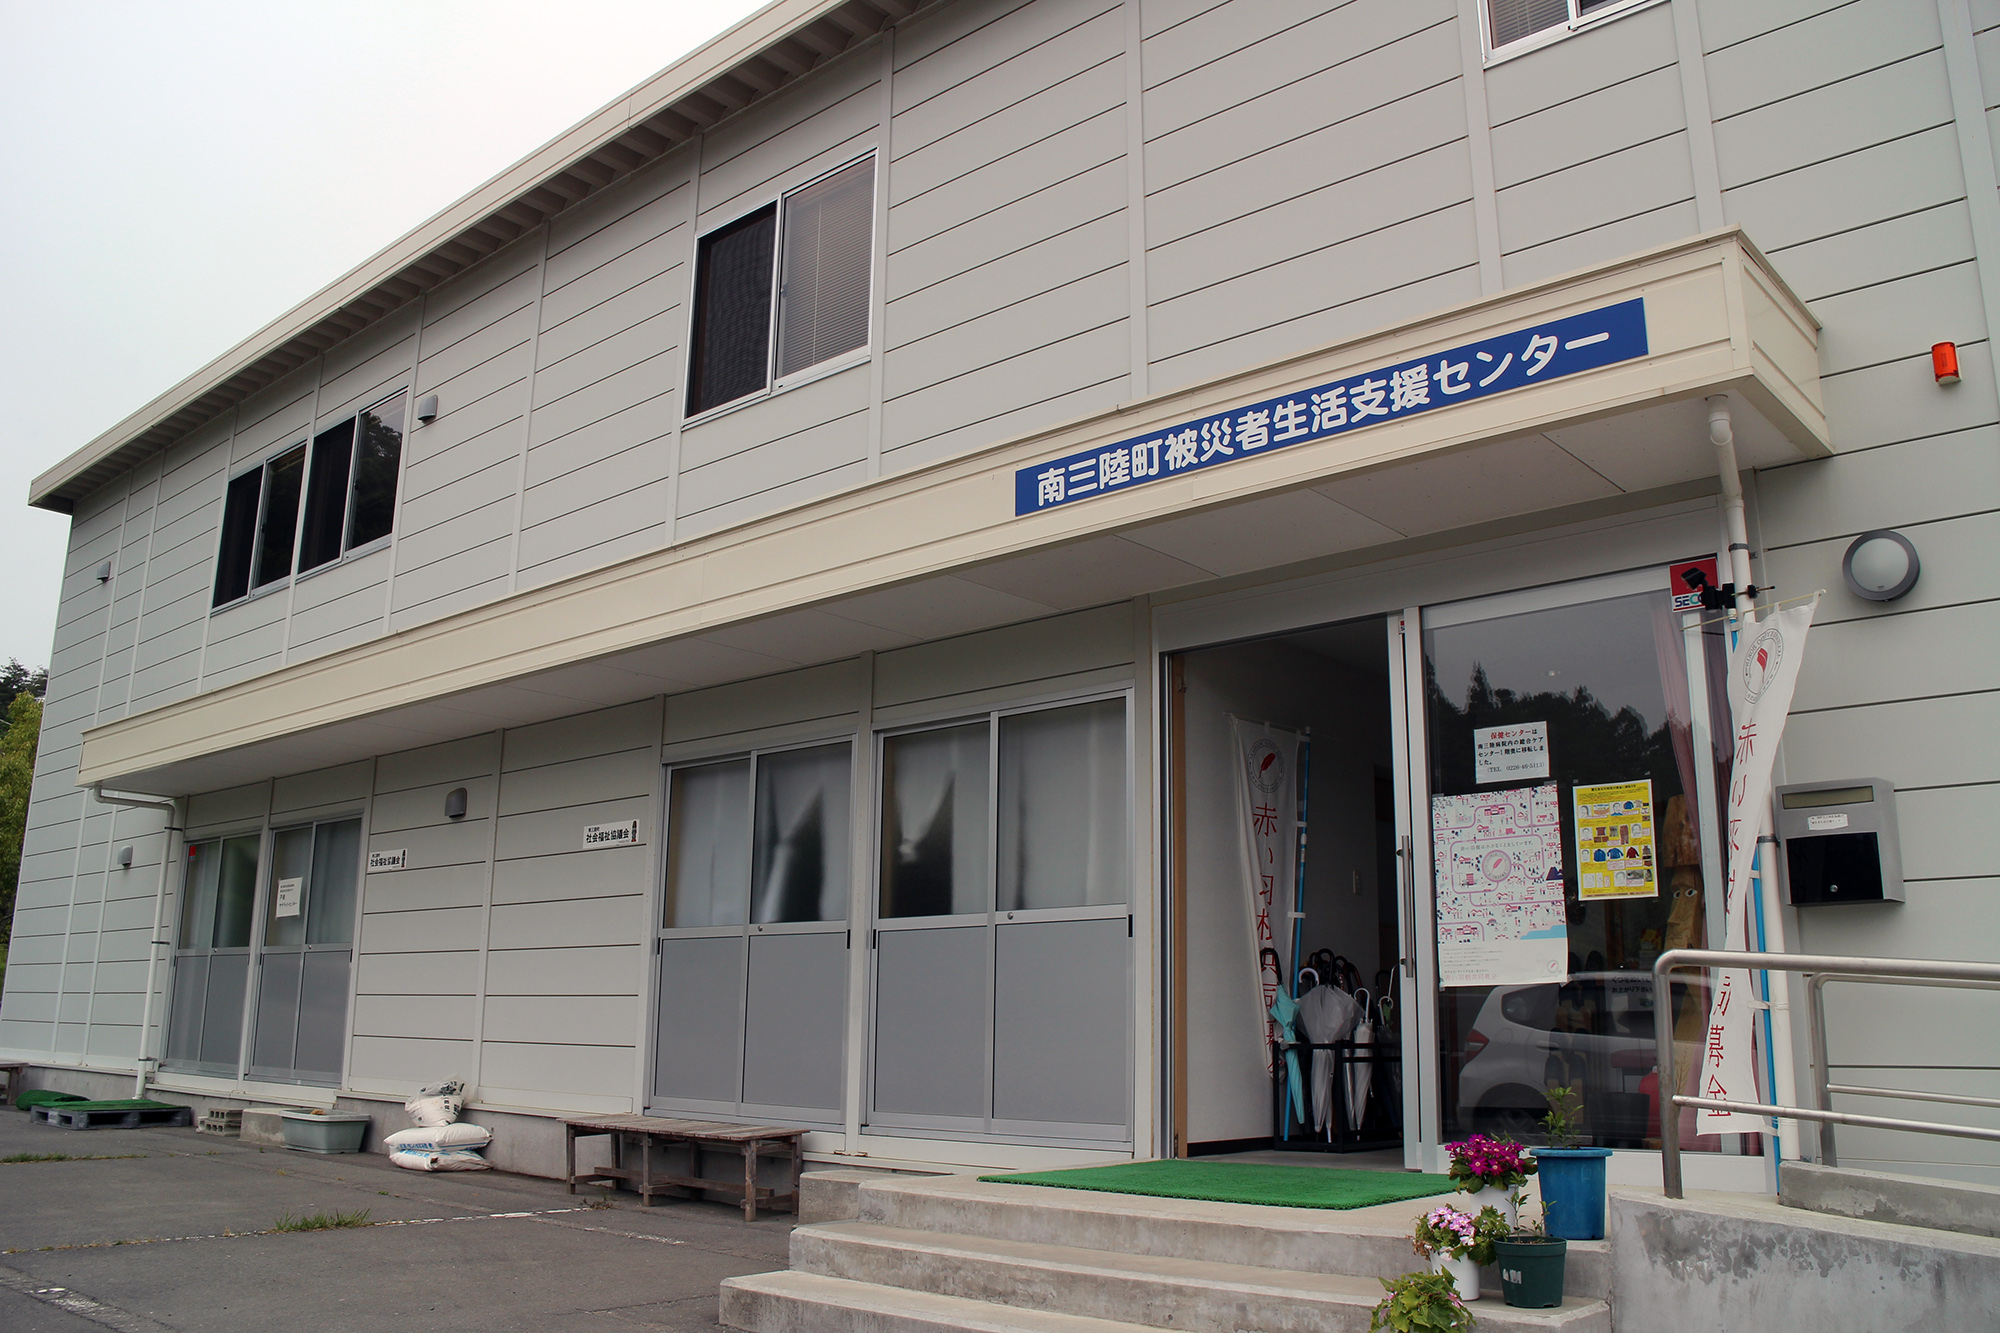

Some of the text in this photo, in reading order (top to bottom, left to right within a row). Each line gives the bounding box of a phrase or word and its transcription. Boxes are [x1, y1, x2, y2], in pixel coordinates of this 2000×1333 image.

[1037, 331, 1609, 507] 南三陸町被災者生活支援センター
[1490, 729, 1538, 740] 保健センターは
[1477, 737, 1544, 750] 南三陸病院内の総合ケア
[586, 828, 630, 843] 社会福祉協議会
[370, 855, 401, 867] 社会福祉協議会
